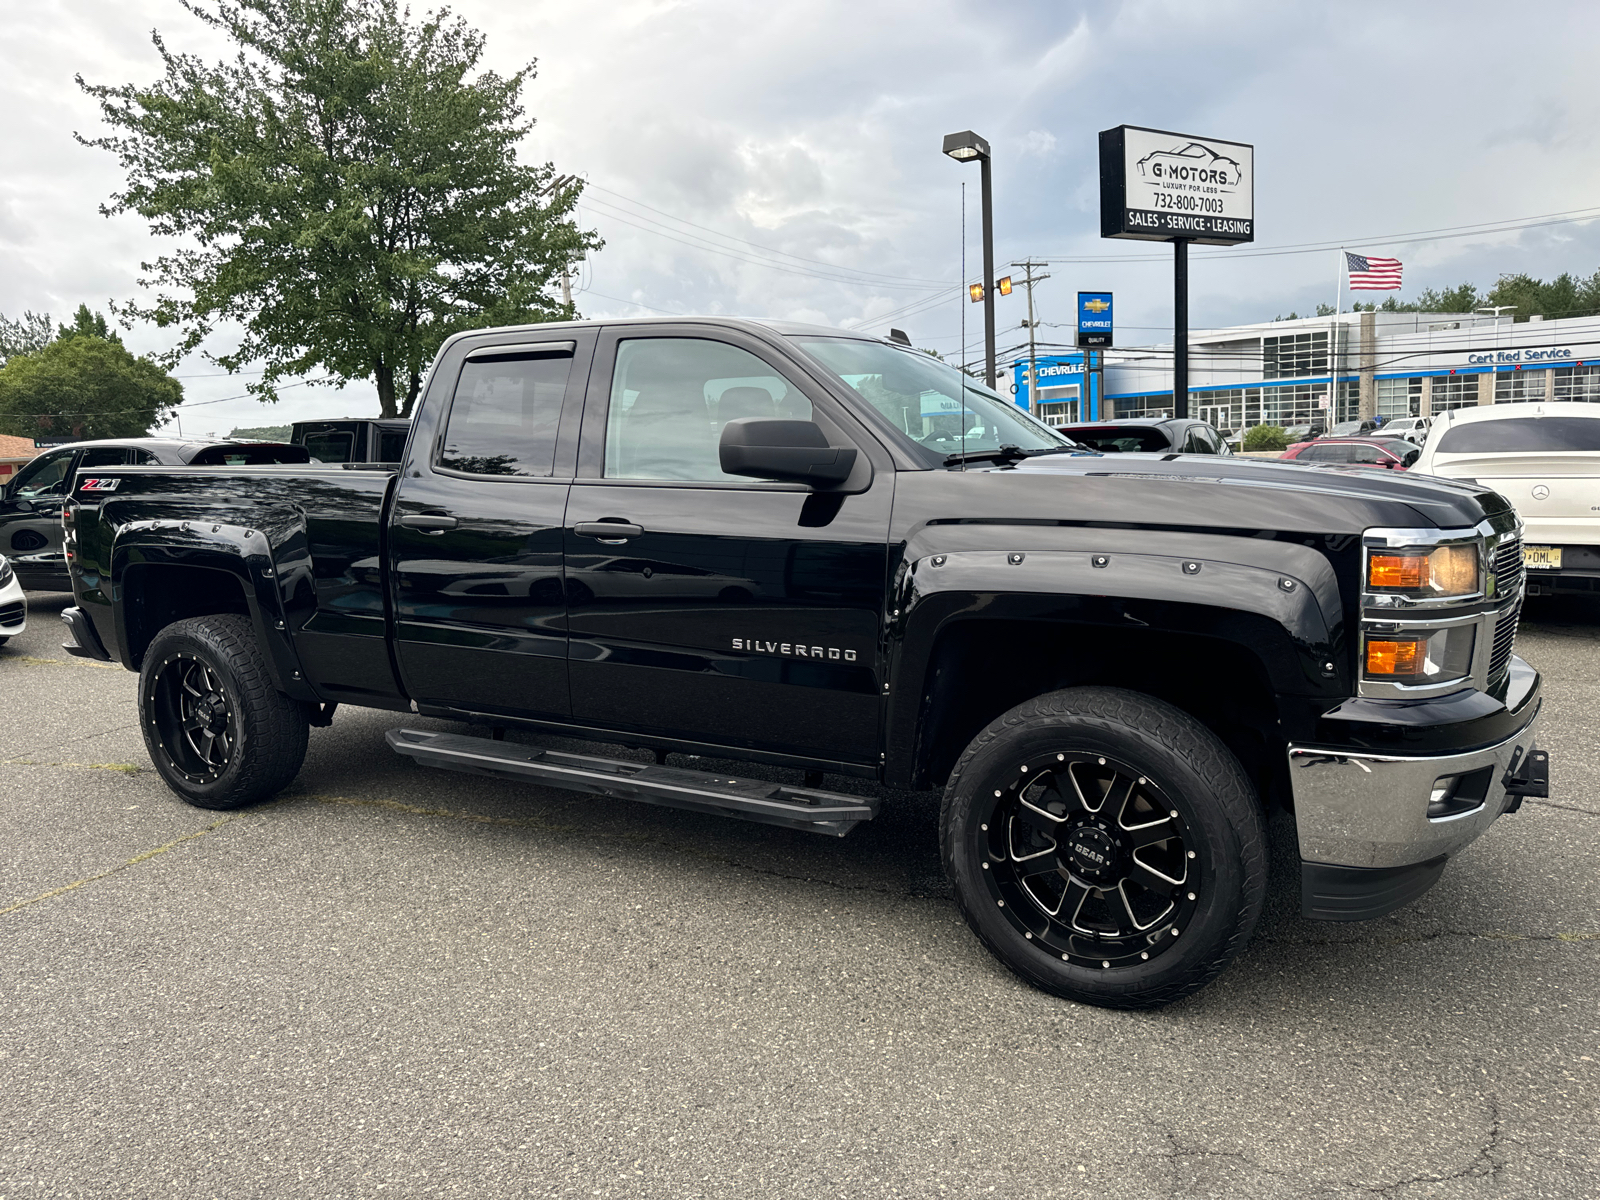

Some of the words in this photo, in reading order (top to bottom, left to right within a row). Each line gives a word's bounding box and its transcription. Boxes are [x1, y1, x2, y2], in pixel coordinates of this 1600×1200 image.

[1162, 181, 1187, 191] LUXURY
[1202, 186, 1218, 194] LESS
[1153, 192, 1224, 214] 732-800-7003
[1128, 211, 1159, 228] SALES
[1166, 214, 1206, 231] SERVICE
[1212, 219, 1251, 235] LEASING
[1081, 320, 1111, 328] CHEVROLET
[1468, 350, 1520, 364] Certfied
[1524, 347, 1572, 360] Service
[80, 478, 122, 491] Z71
[732, 638, 857, 661] SILVERADO
[1074, 843, 1105, 864] GEAR
